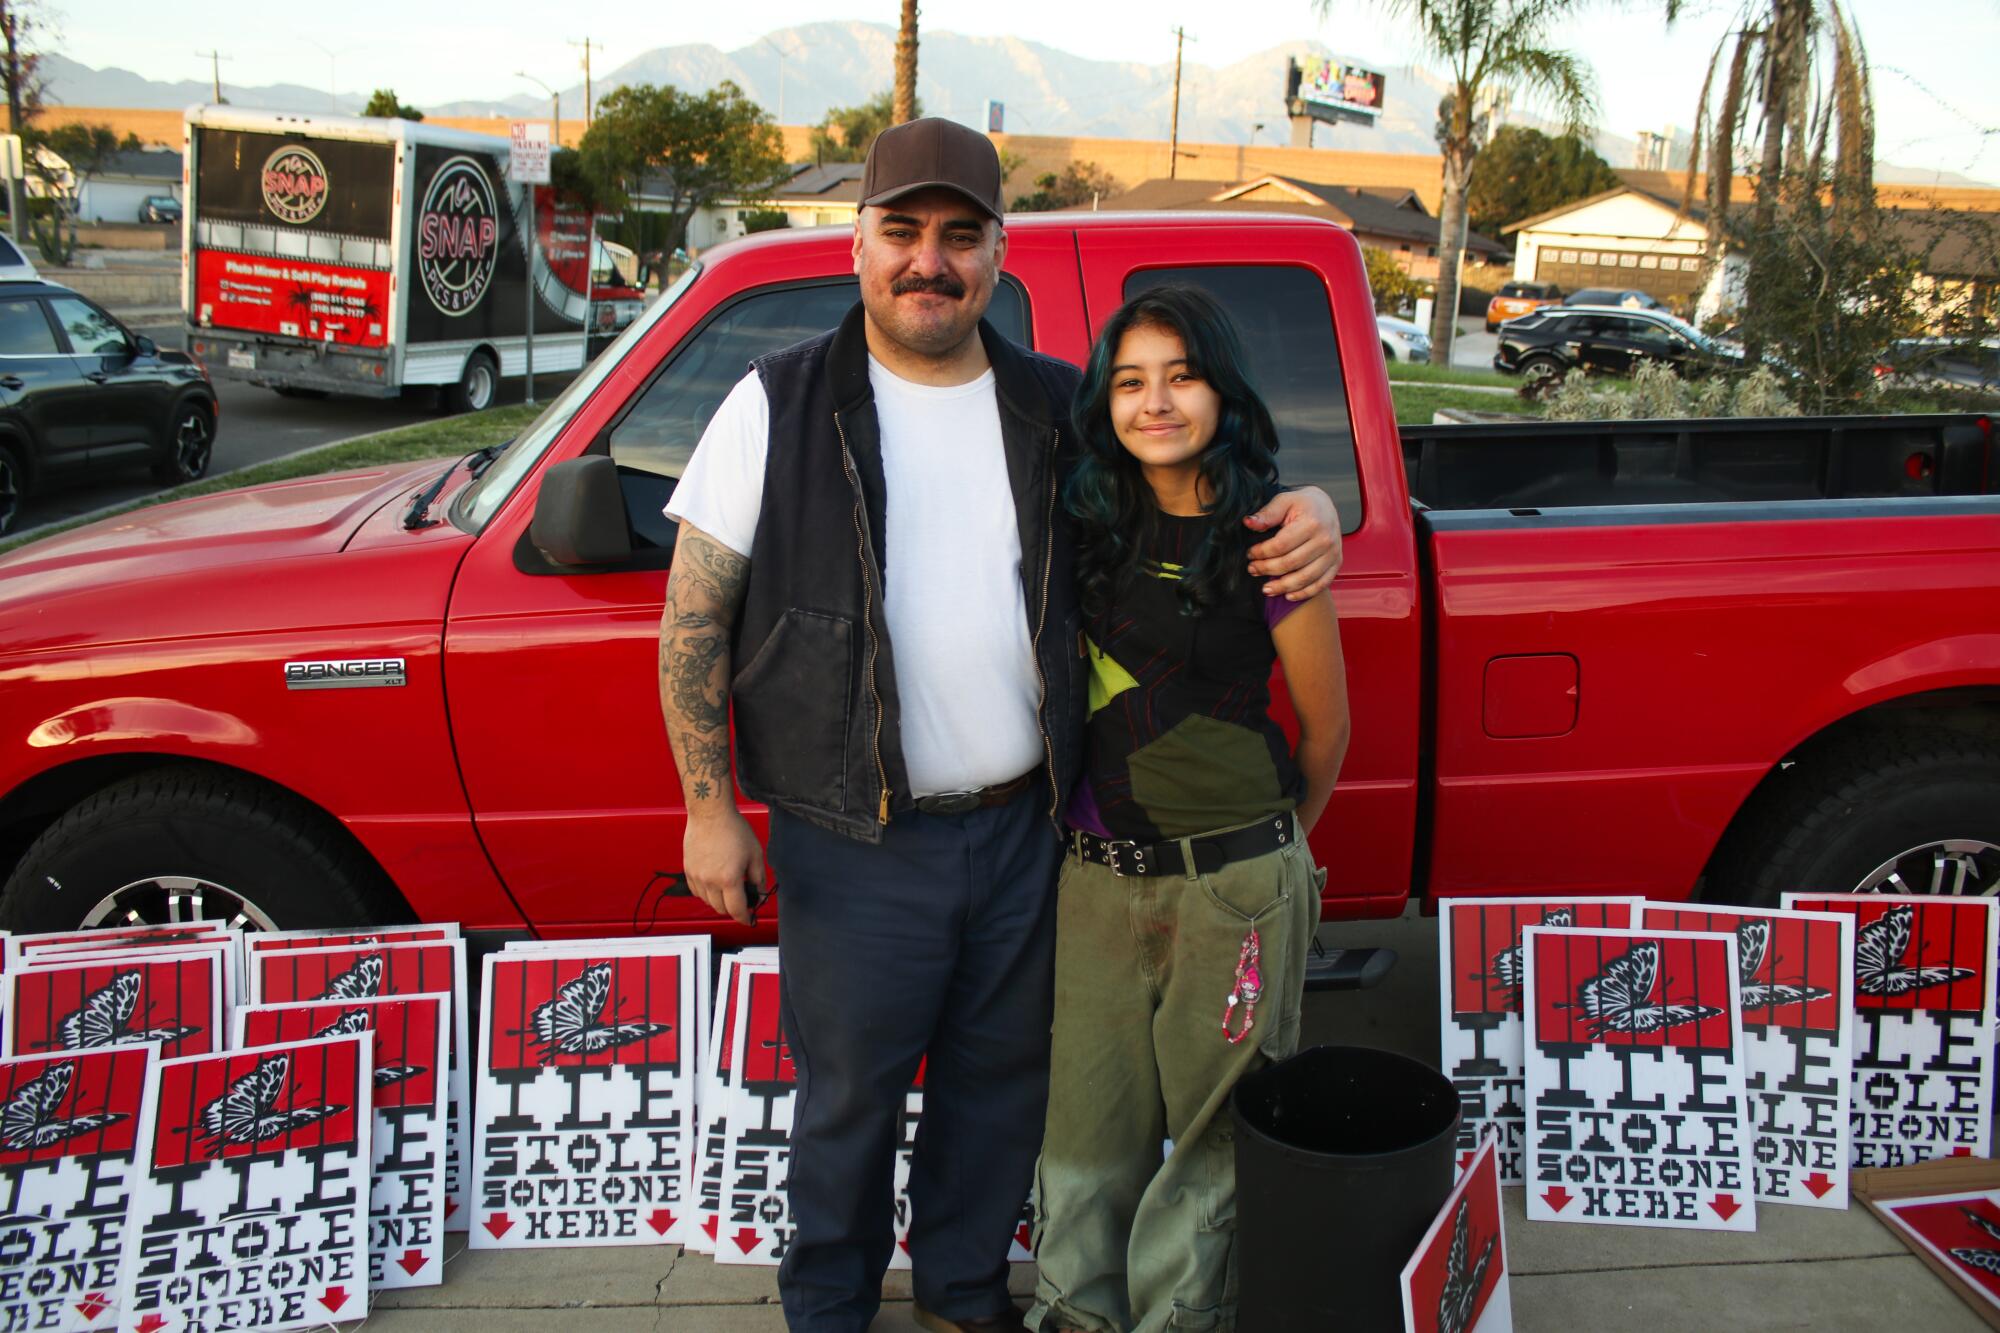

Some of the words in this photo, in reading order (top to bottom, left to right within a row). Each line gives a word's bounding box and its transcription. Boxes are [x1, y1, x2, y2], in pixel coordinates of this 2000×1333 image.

[512, 123, 526, 139] NO
[265, 170, 325, 197] SNAP
[421, 212, 496, 260] SNAP
[226, 261, 253, 275] Photo
[254, 264, 281, 279] Mirror
[282, 269, 290, 280] &
[291, 269, 311, 283] Soft
[311, 272, 332, 287] Play
[332, 274, 367, 290] Rentals
[427, 268, 450, 306] PICS
[451, 292, 460, 310] &
[462, 270, 486, 306] PLAY
[287, 661, 402, 680] RANGER
[1852, 1008, 1984, 1073] CE
[486, 1063, 681, 1133] ICE
[1536, 1042, 1737, 1113] ICE
[1851, 1072, 1981, 1114] OLE
[484, 1131, 681, 1177] STOLE
[1536, 1109, 1739, 1157] STOLE
[1537, 1153, 1741, 1190] SOMEONE
[1852, 1142, 1933, 1168] ERE
[0, 1149, 134, 1227] CE
[142, 1141, 358, 1234] ICE
[482, 1174, 681, 1209] SOMEONE
[1582, 1187, 1698, 1221] HERE
[0, 1214, 127, 1267] OLE
[137, 1208, 355, 1278] STOLE
[525, 1208, 637, 1240] HERE
[0, 1258, 121, 1301] EONE
[133, 1252, 353, 1311] SOMEONE
[181, 1291, 306, 1333] HERE
